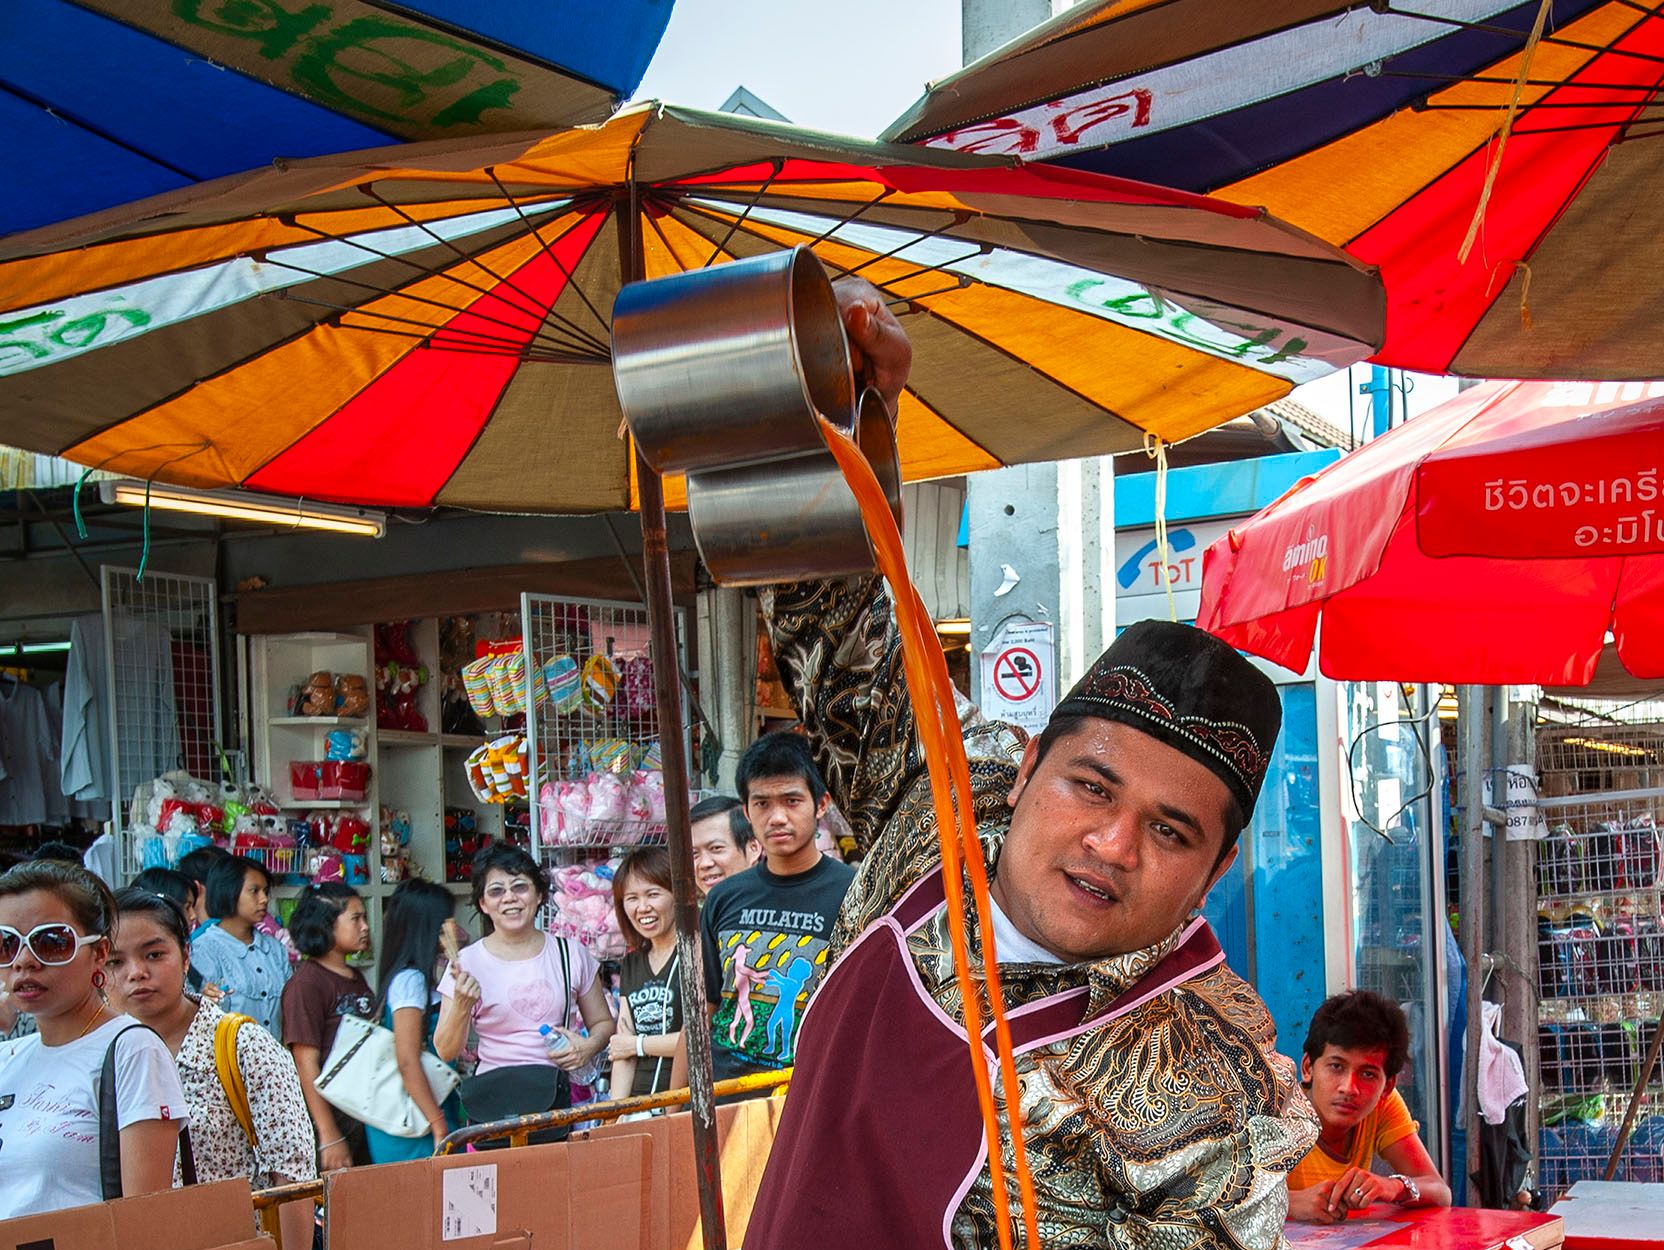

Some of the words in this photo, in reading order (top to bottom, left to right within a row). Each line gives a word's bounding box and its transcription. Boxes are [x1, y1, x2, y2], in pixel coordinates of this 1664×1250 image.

[1484, 467, 1664, 511] ชีวิตจะเครี
[739, 909, 825, 933] MULATE'S
